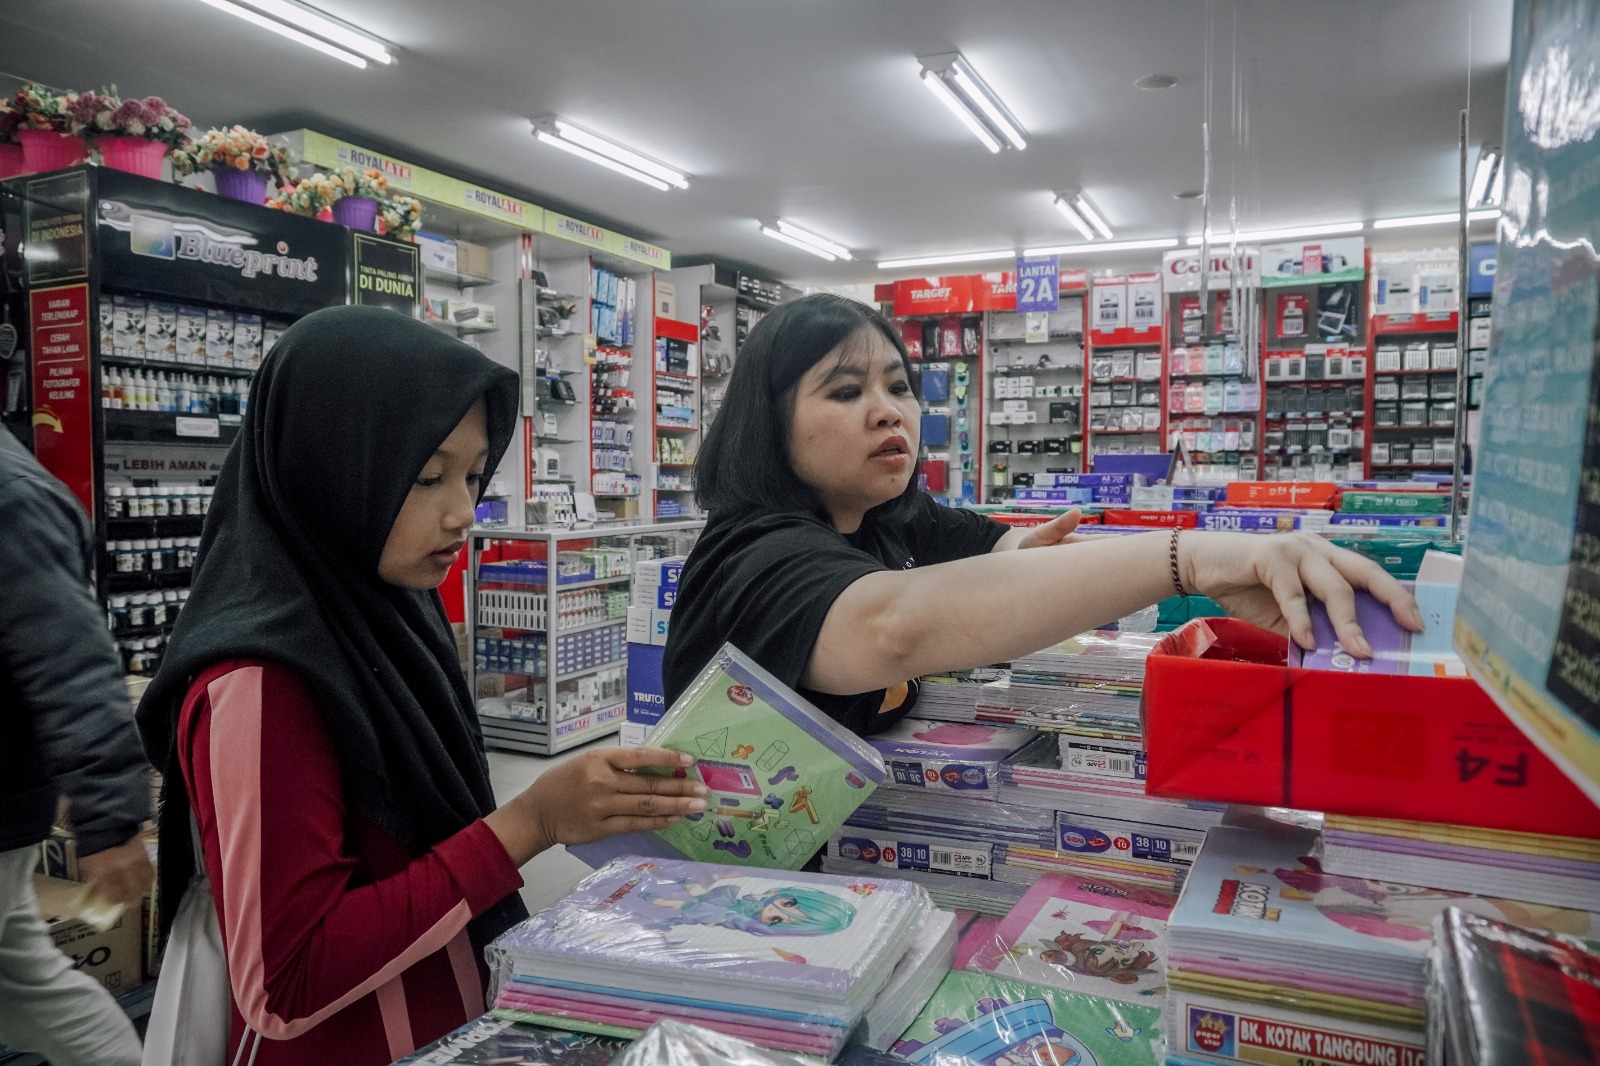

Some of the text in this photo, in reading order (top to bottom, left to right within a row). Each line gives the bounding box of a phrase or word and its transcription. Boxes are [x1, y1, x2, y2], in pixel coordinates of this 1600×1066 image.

[350, 149, 411, 179] ROYAL ATK
[475, 190, 522, 215] ROYAL ATK
[566, 220, 586, 235] ROYAL
[177, 231, 318, 282] Blueprint
[1020, 265, 1056, 277] LANTAI
[360, 274, 414, 298] DI DUNIA
[1021, 278, 1054, 303] 2A
[911, 287, 952, 299] TARGET
[123, 460, 164, 470] LEBIH
[168, 460, 207, 470] AMAN
[1205, 516, 1242, 530] SiDU
[1259, 517, 1273, 525] F4
[1453, 747, 1529, 788] F4
[897, 772, 907, 781] 10
[910, 773, 921, 783] 38
[1117, 841, 1127, 849] 10
[1136, 837, 1150, 848] 38
[1155, 839, 1167, 850] 10
[885, 852, 893, 860] 10
[901, 847, 912, 858] 38
[916, 848, 926, 860] 10
[1196, 1031, 1221, 1040] paper
[1203, 1038, 1221, 1047] star
[1241, 1020, 1262, 1044] BK.
[1265, 1025, 1312, 1053] KOTAK
[1314, 1033, 1398, 1066] TANGGUNG
